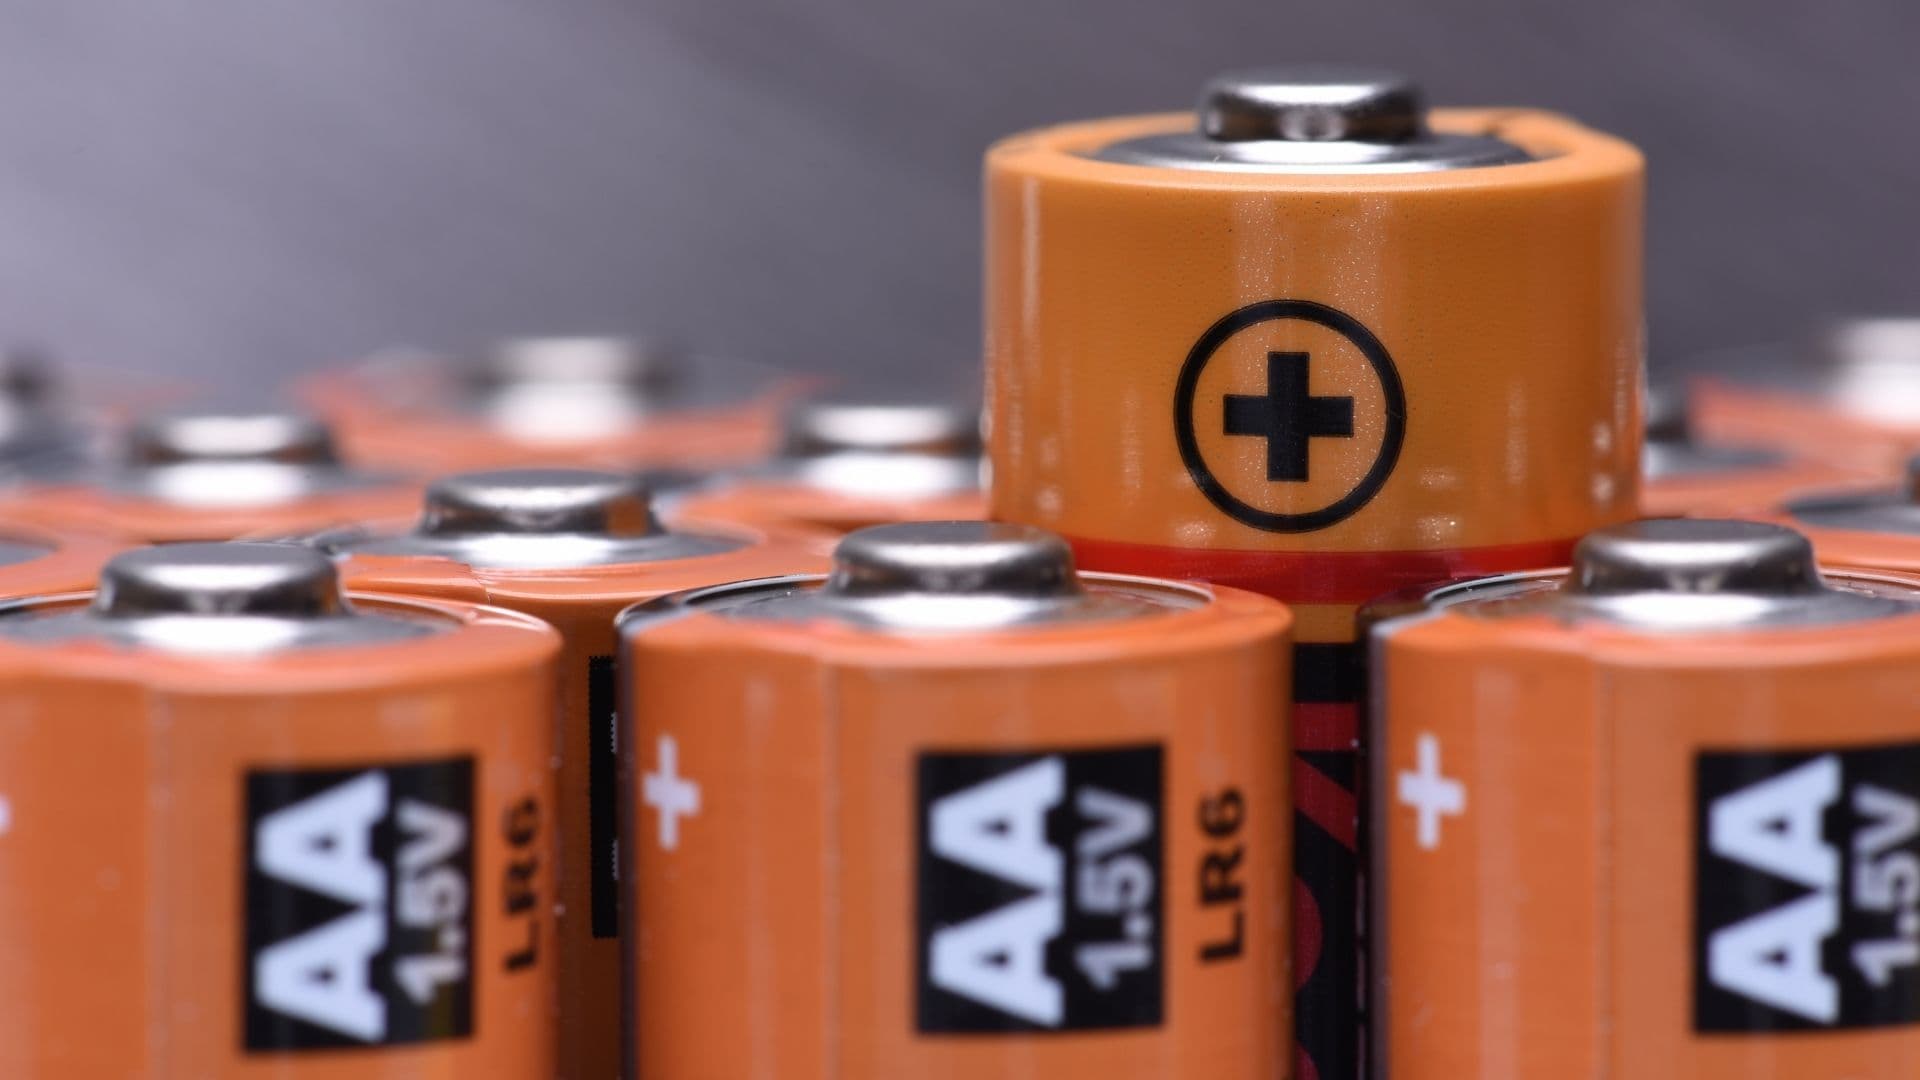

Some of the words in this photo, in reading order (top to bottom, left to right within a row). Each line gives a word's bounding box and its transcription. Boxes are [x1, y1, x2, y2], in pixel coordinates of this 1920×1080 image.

[255, 769, 389, 1043] AA
[393, 797, 468, 1007] 1.5V
[501, 797, 541, 973] LR6
[929, 755, 1066, 1028] AA
[1075, 785, 1156, 991] 1.5V
[1197, 788, 1246, 965] LR6
[1708, 752, 1844, 1025] AA
[1851, 783, 1920, 989] 1.5V
